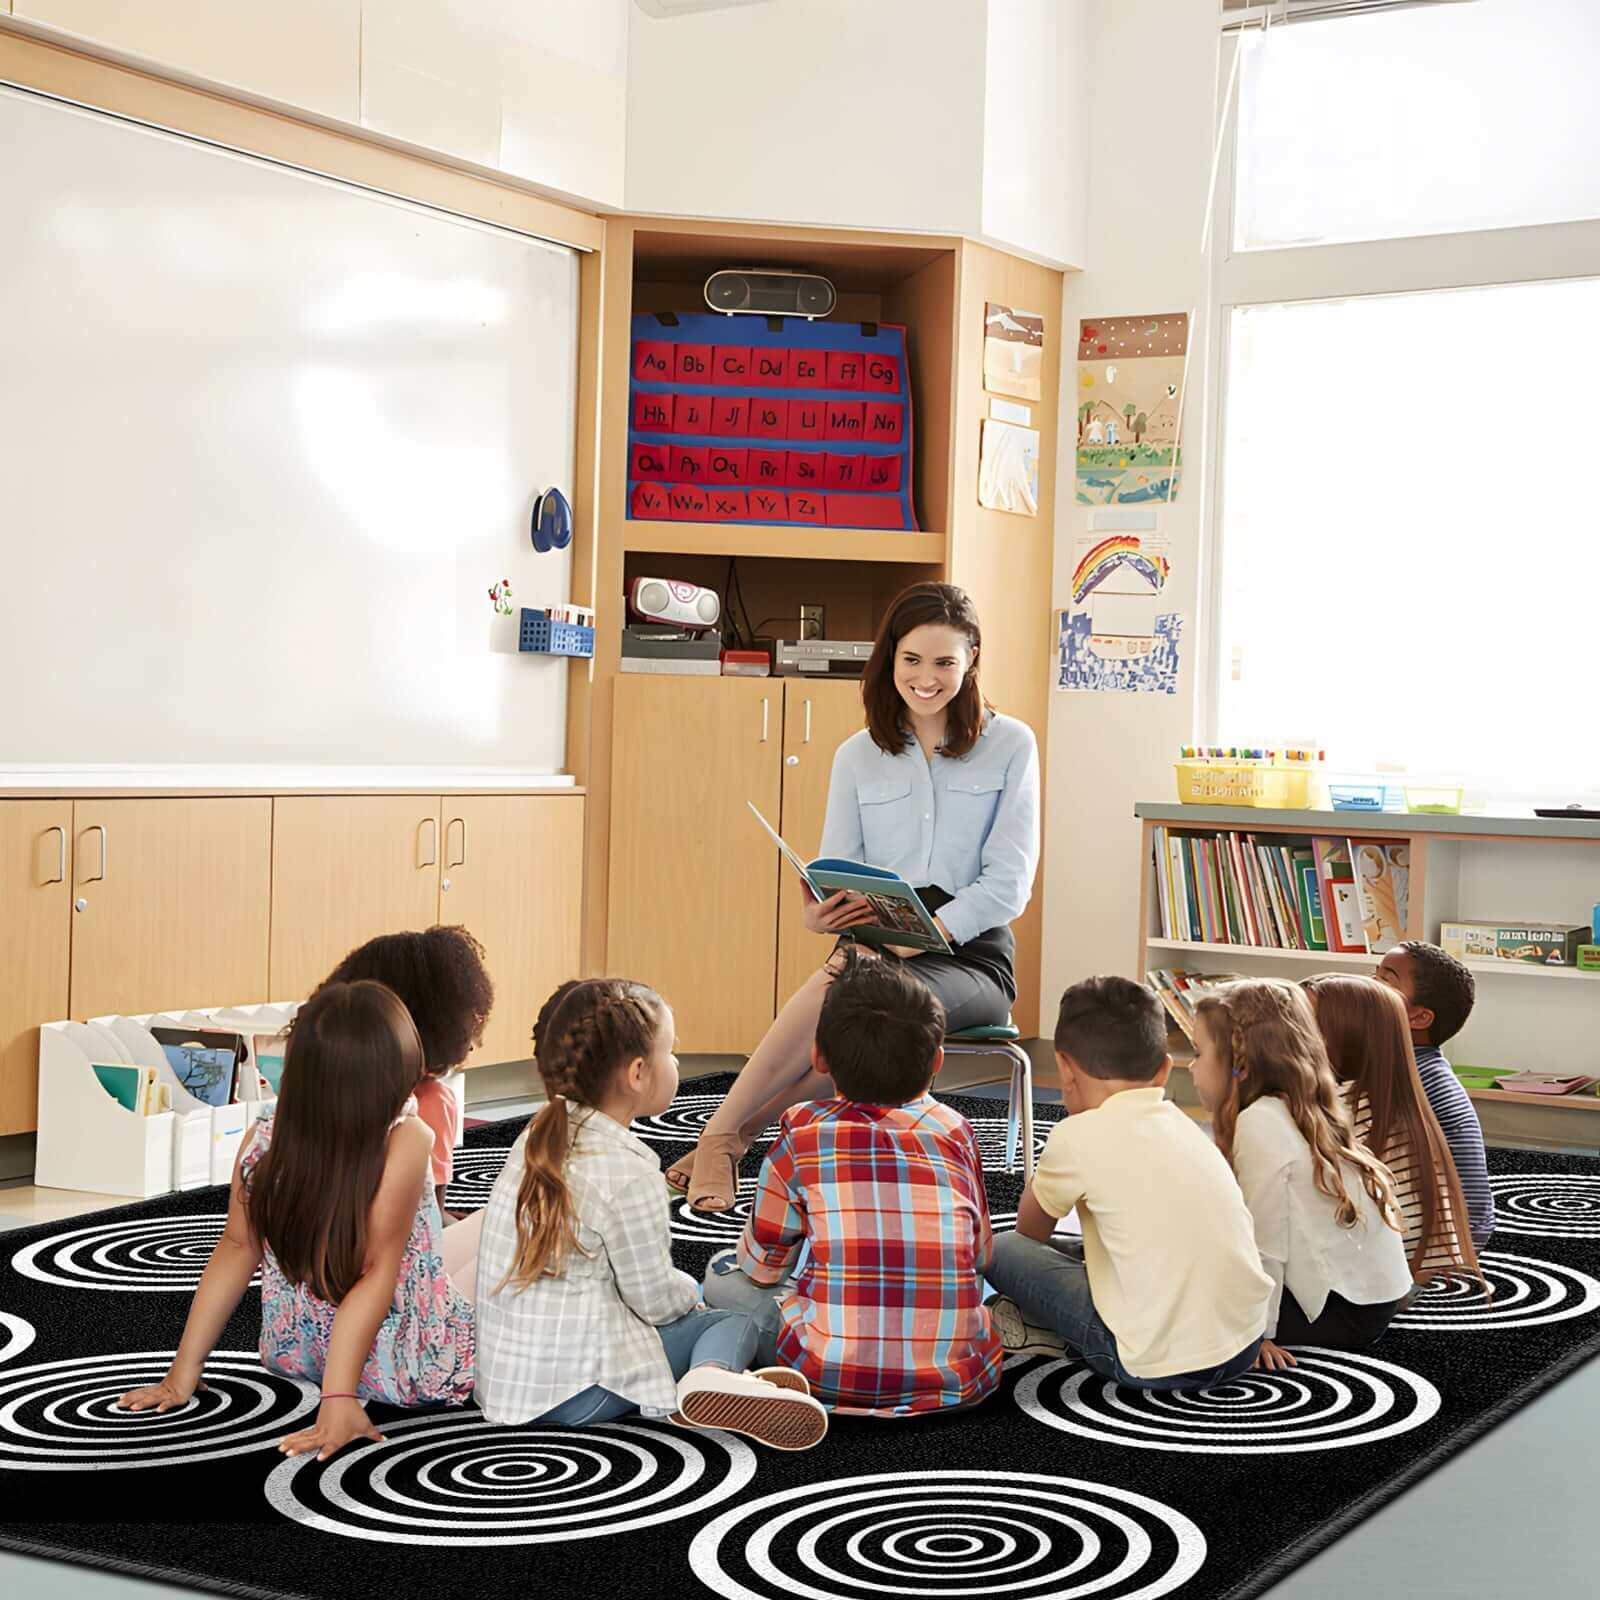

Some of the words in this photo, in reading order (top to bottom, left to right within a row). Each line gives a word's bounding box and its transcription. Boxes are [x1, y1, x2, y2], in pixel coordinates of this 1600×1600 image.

[683, 355, 705, 373] Bb
[723, 358, 745, 374] Cc
[760, 359, 782, 375] Dd
[869, 362, 894, 385] Gg
[643, 405, 666, 421] Hh
[831, 412, 860, 429] Mm
[874, 413, 896, 431] Nn
